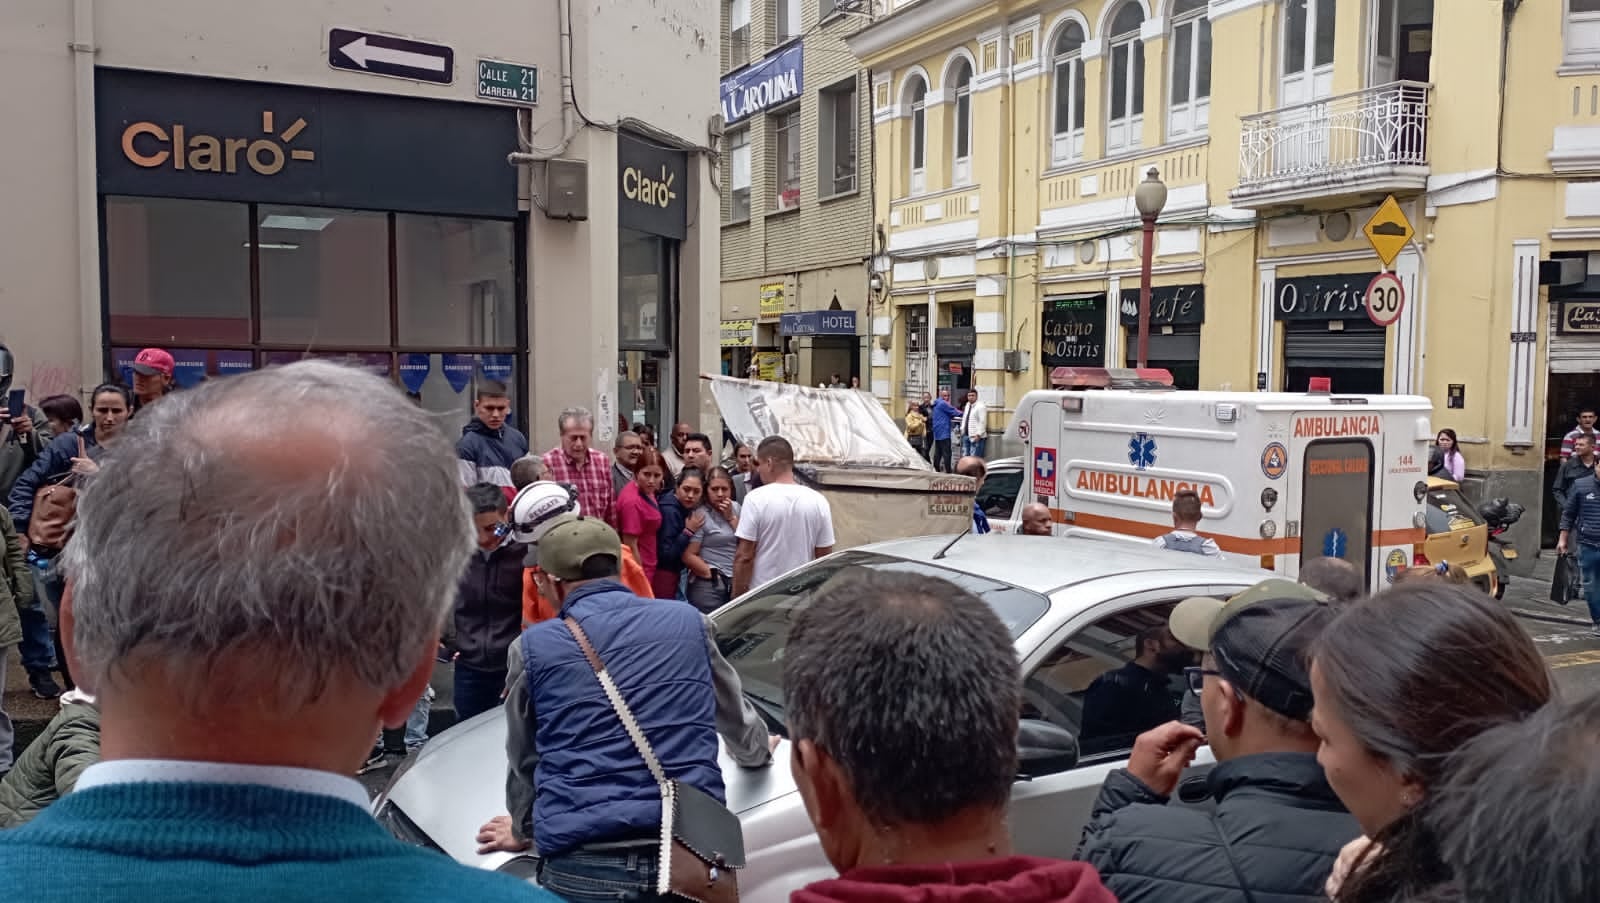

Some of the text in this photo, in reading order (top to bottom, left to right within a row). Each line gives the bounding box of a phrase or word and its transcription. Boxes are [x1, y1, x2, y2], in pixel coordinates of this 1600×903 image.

[480, 62, 534, 86] CALLE 21
[479, 81, 534, 100] CARRERA 21
[729, 68, 798, 119] CAROLINA
[121, 121, 286, 176] Claro
[623, 166, 670, 208] Claro
[1149, 287, 1193, 322] afé
[1279, 283, 1361, 313] Osiris
[1372, 286, 1399, 313] 30
[822, 316, 855, 329] HOTEL
[1044, 319, 1093, 337] Casino
[1056, 341, 1100, 358] Osiris
[1293, 415, 1380, 438] AMBULANCIA
[528, 498, 560, 520] RESCATE
